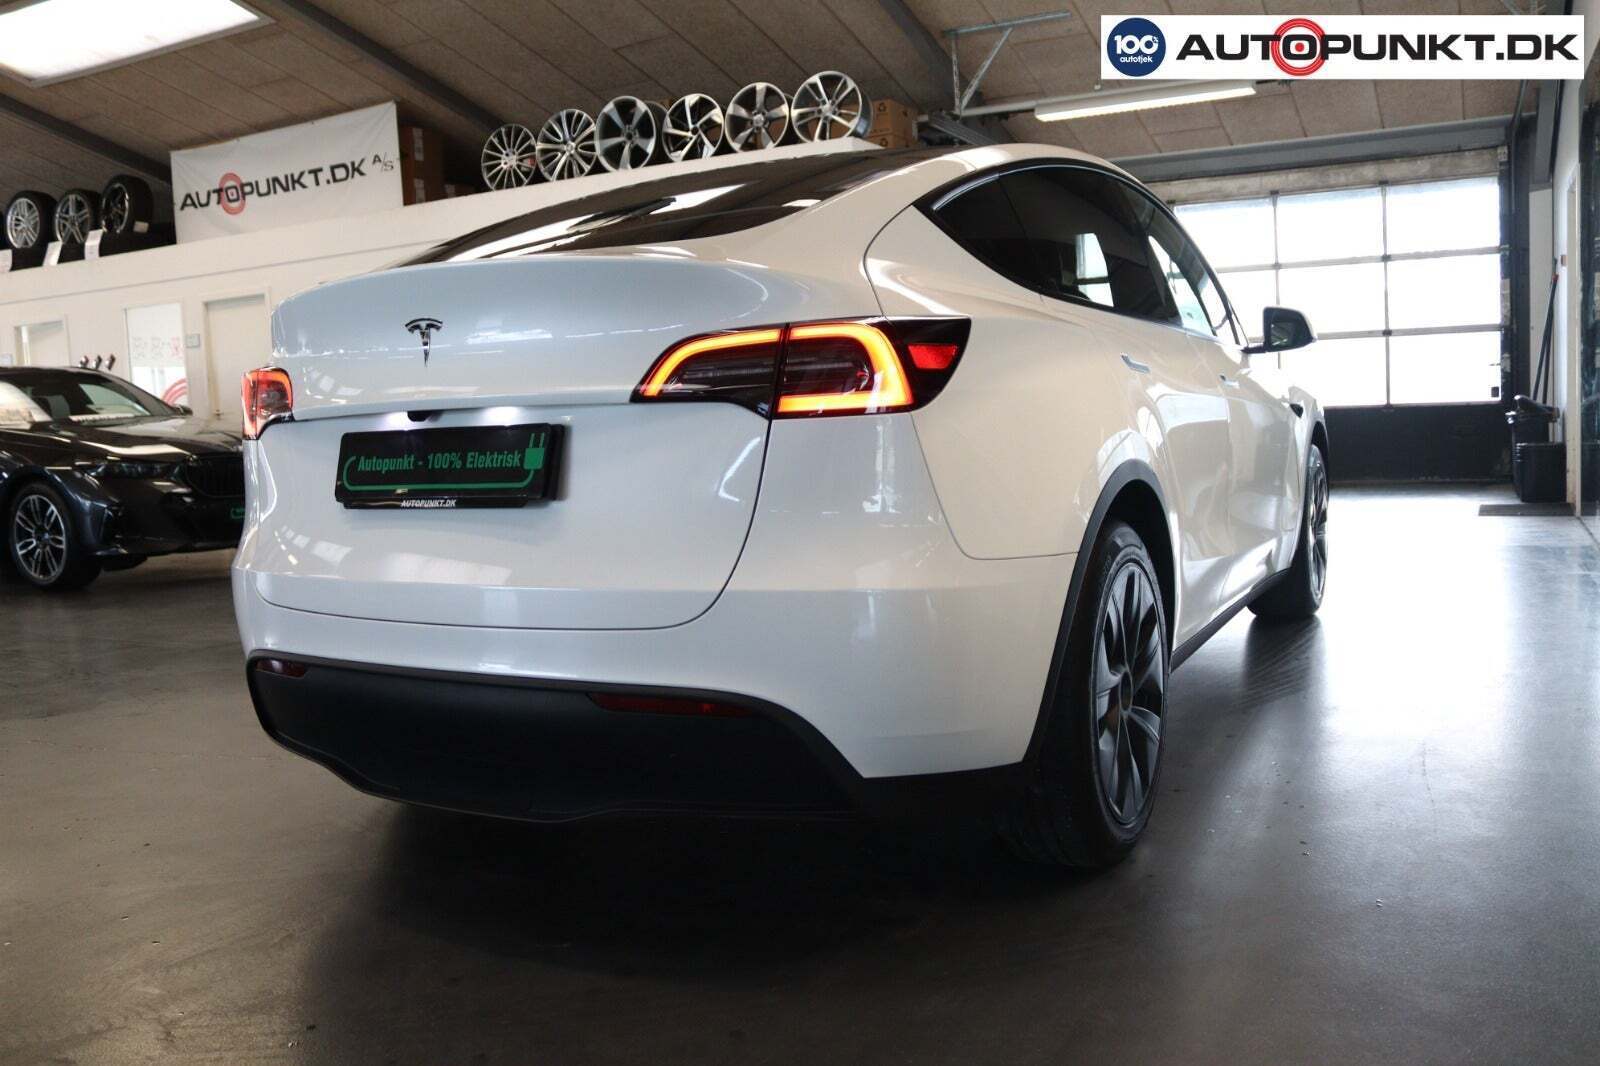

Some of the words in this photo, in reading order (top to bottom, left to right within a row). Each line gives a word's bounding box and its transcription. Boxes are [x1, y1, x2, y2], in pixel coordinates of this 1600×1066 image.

[180, 158, 367, 211] AUTOPUNKT.DK
[372, 151, 394, 172] A/S
[357, 455, 415, 474] Autopunkt
[427, 453, 462, 469] 100%
[466, 450, 521, 468] Elektrisk
[400, 499, 457, 508] AUTOPUNKT.DK
